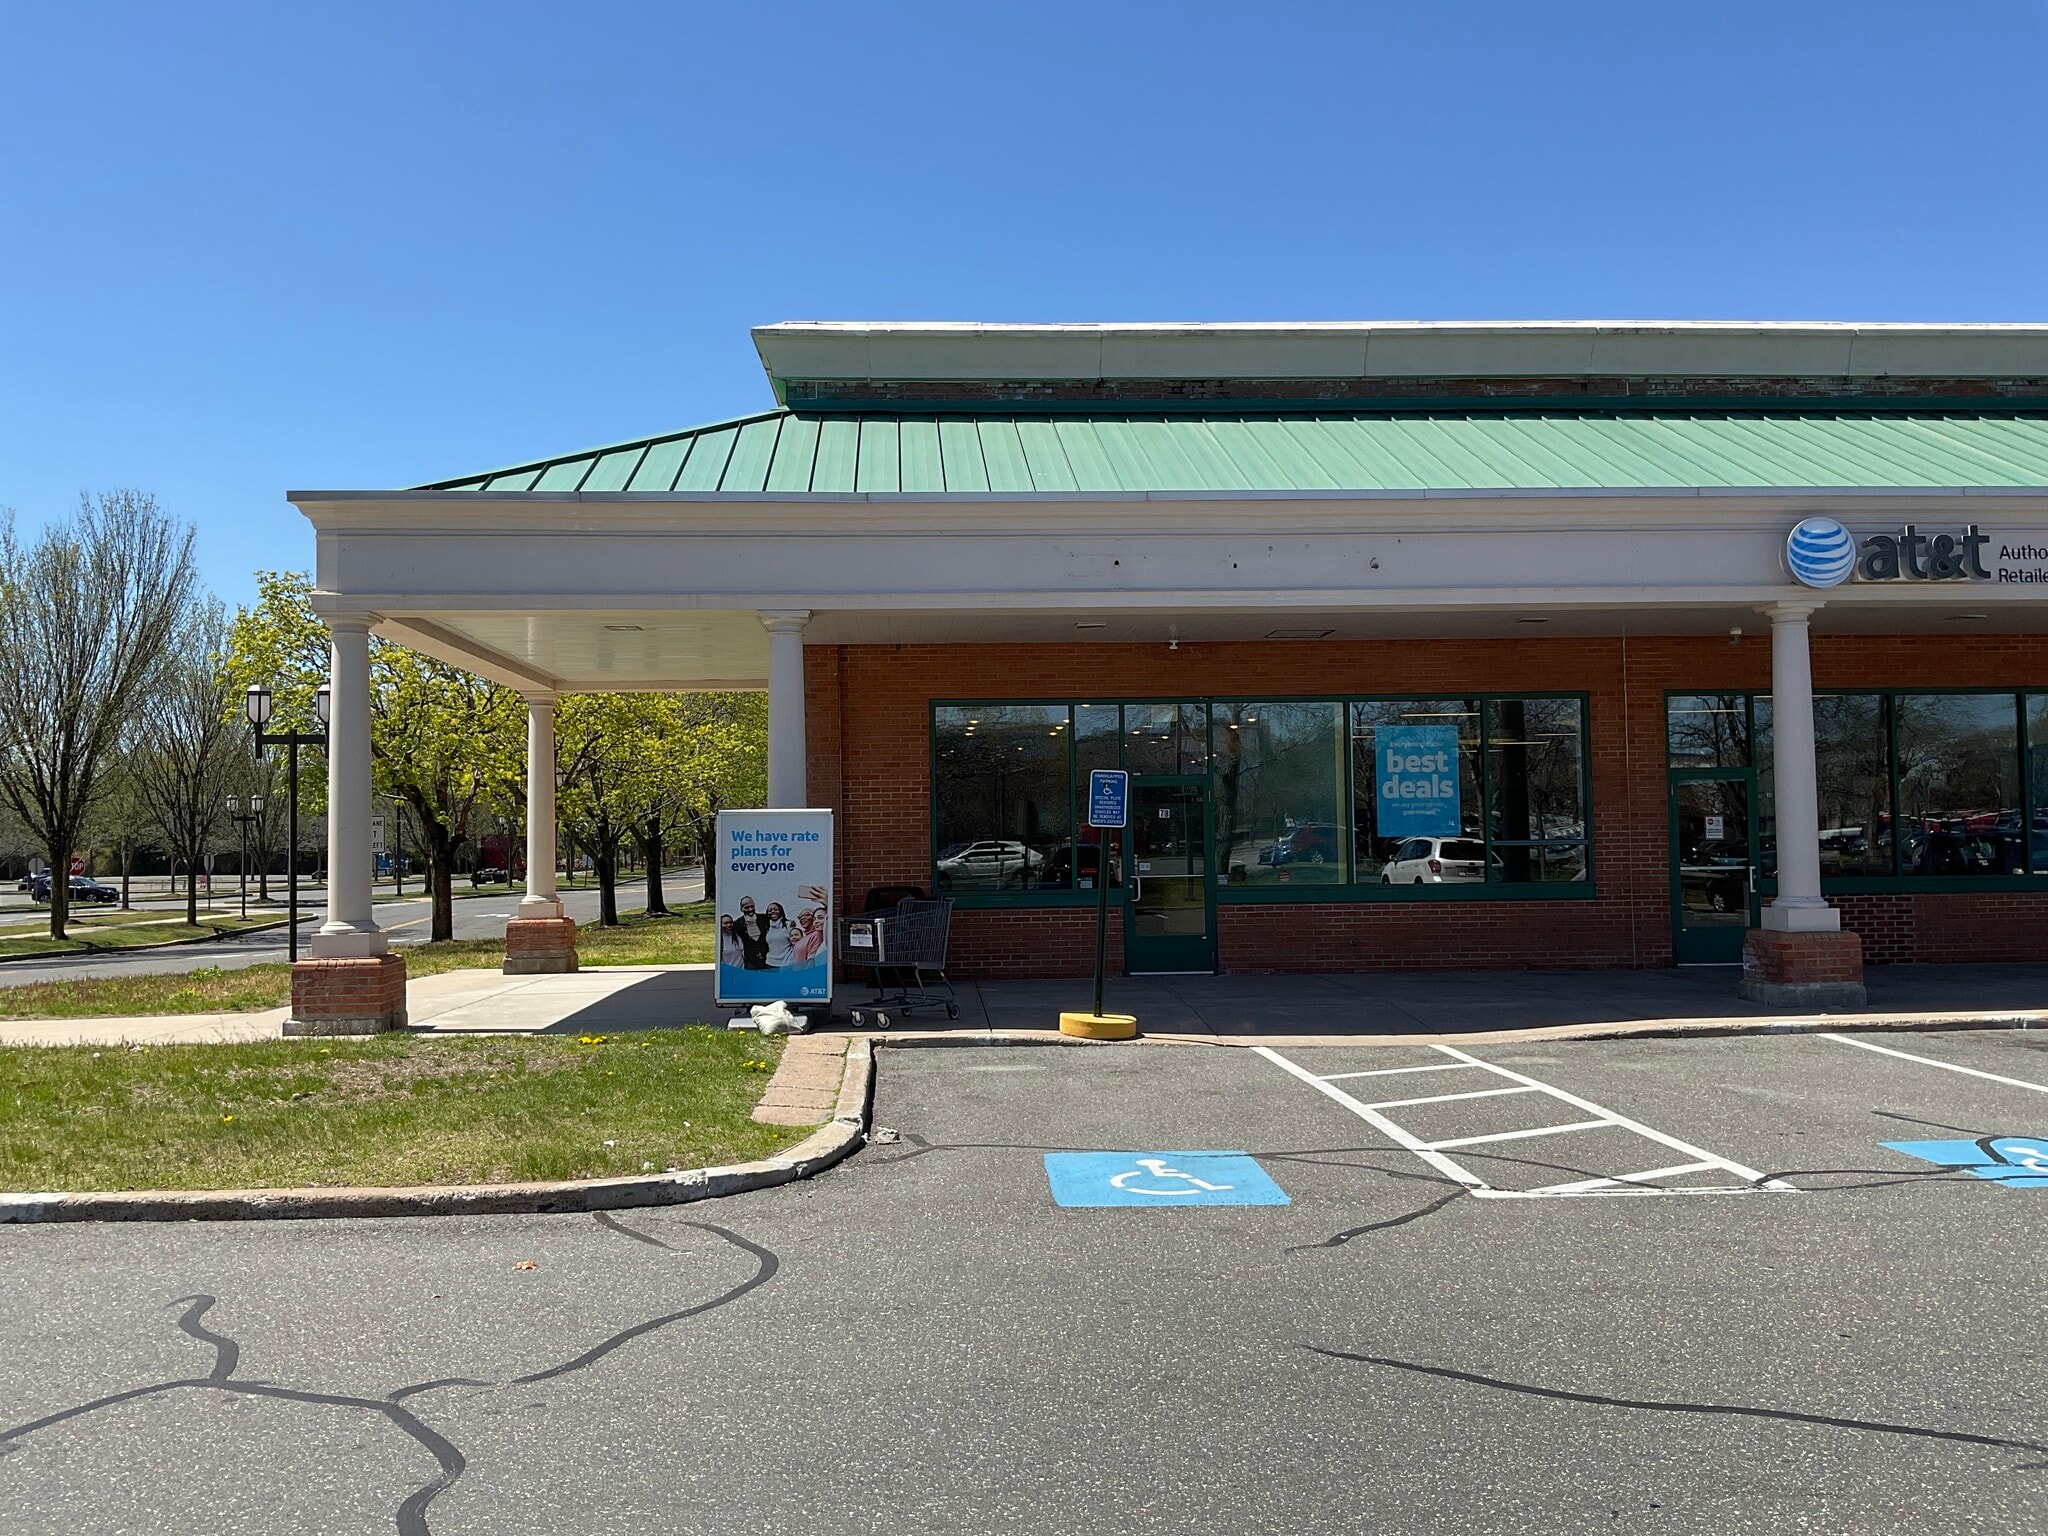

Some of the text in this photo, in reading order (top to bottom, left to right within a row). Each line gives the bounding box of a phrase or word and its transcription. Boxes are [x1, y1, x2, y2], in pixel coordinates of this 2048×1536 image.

[1858, 525, 1991, 580] at&t
[1999, 545, 2048, 560] Autho
[1998, 568, 2048, 584] Retaile
[1387, 749, 1449, 773] best
[1382, 774, 1454, 799] deals
[731, 830, 819, 842] We have rate
[731, 845, 792, 860] plans for
[70, 862, 84, 870] TOP
[731, 862, 795, 874] everyone
